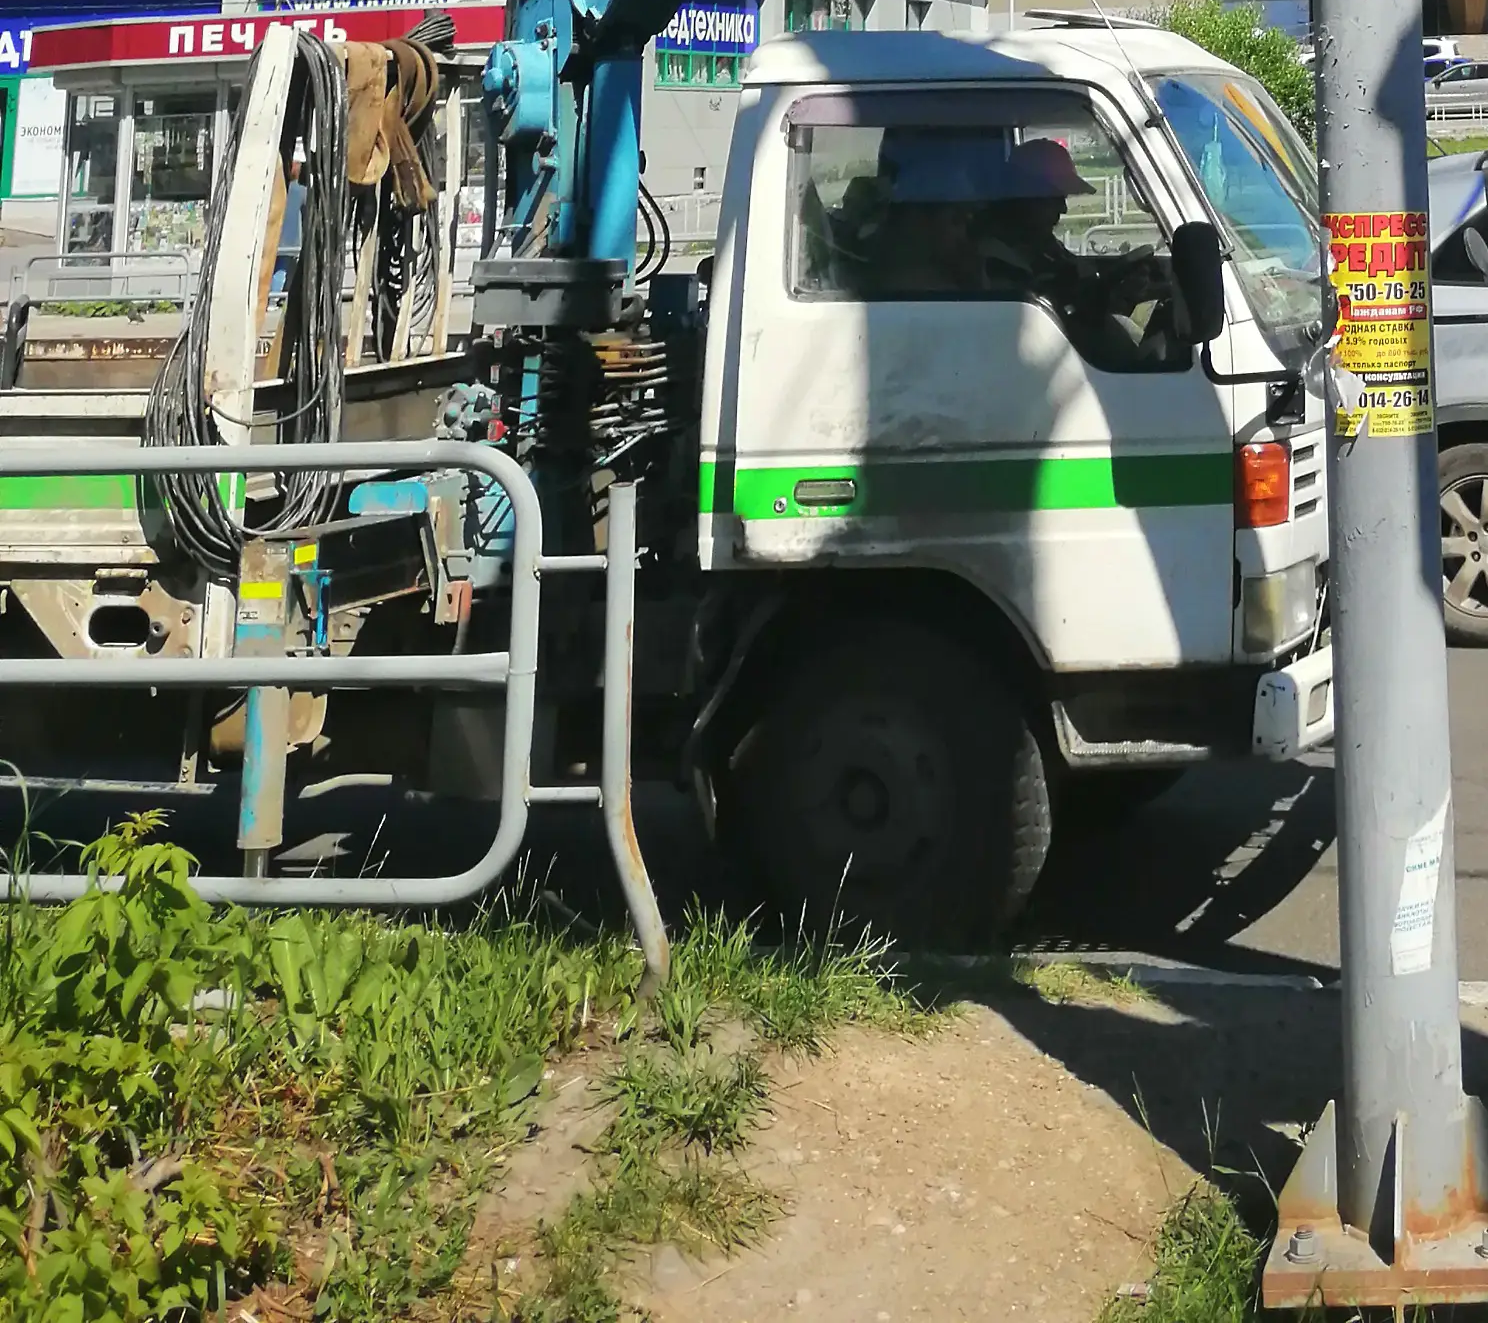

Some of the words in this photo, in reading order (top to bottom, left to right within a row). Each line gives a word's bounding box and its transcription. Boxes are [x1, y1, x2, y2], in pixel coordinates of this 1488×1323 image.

[168, 18, 348, 54] ПЕЧТЬ
[657, 8, 755, 46] едтехника
[1351, 306, 1406, 318] ажданам
[1379, 322, 1415, 335] СТАВКА
